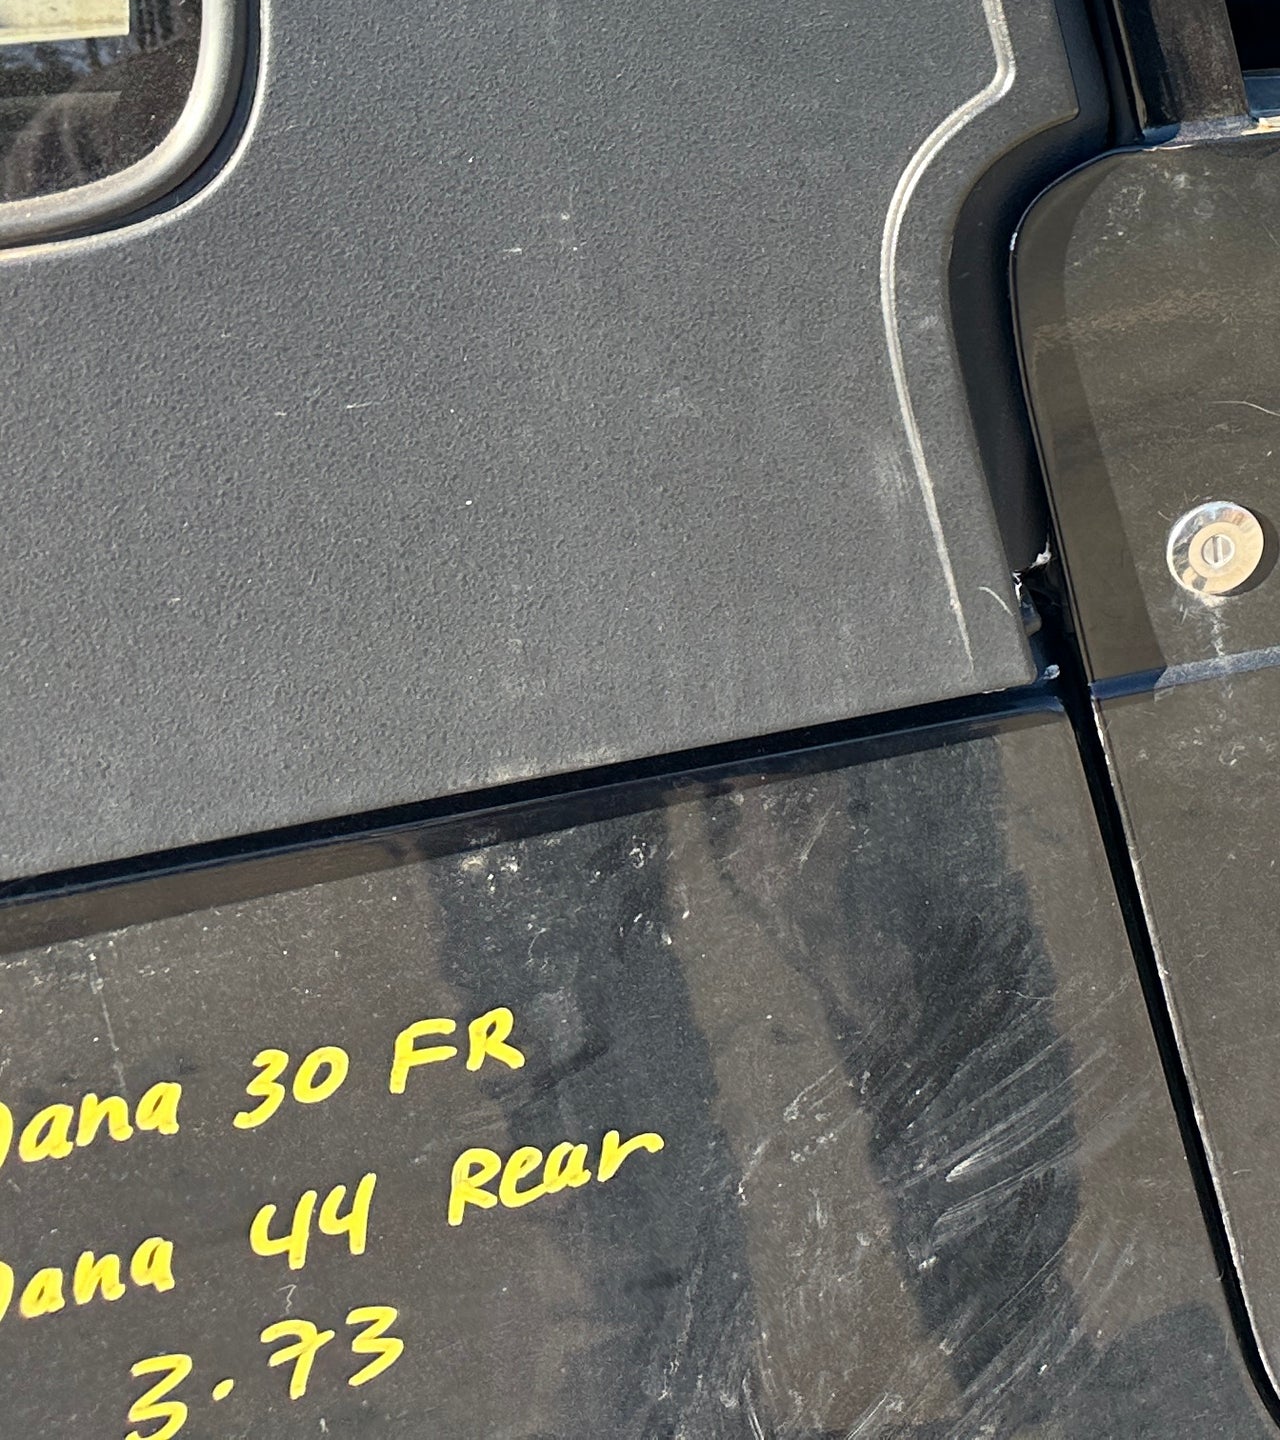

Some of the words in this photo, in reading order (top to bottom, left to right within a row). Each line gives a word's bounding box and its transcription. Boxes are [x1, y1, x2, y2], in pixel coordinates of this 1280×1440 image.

[233, 1046, 349, 1129] 30
[389, 1007, 524, 1095] FR
[249, 1173, 377, 1269] 44
[447, 1130, 664, 1225] Rear
[124, 1305, 404, 1440] 3.73
